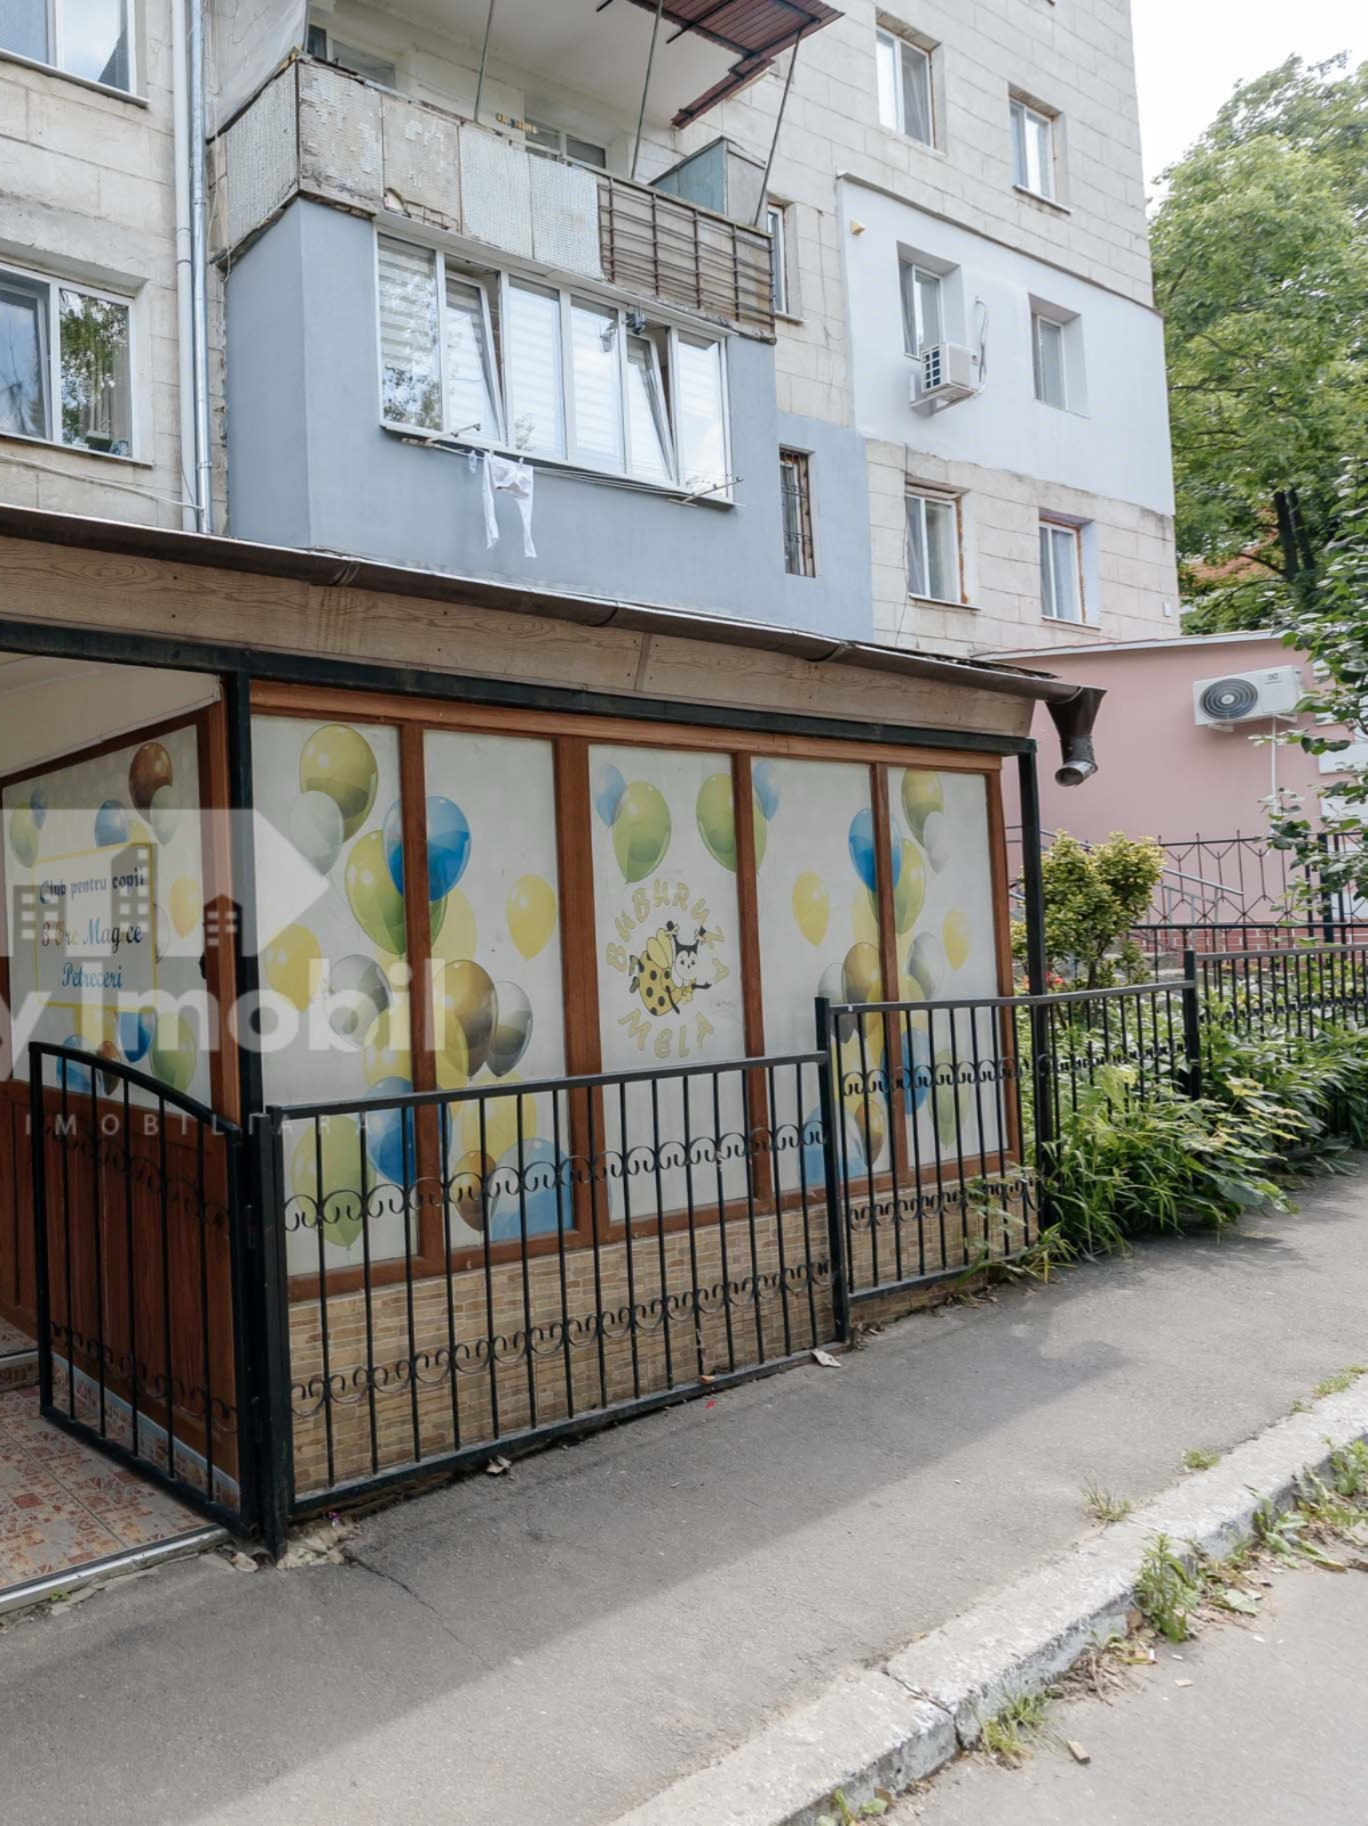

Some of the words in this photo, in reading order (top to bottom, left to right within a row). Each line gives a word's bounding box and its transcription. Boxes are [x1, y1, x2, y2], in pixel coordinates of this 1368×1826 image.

[40, 878, 66, 904] Club
[70, 876, 107, 899] pentru
[112, 866, 144, 894] copii
[41, 921, 51, 947] 3
[55, 920, 78, 946] Ore
[606, 878, 730, 984] BUBURUZA
[62, 961, 122, 989] Petreceri
[617, 1008, 714, 1058] MELA
